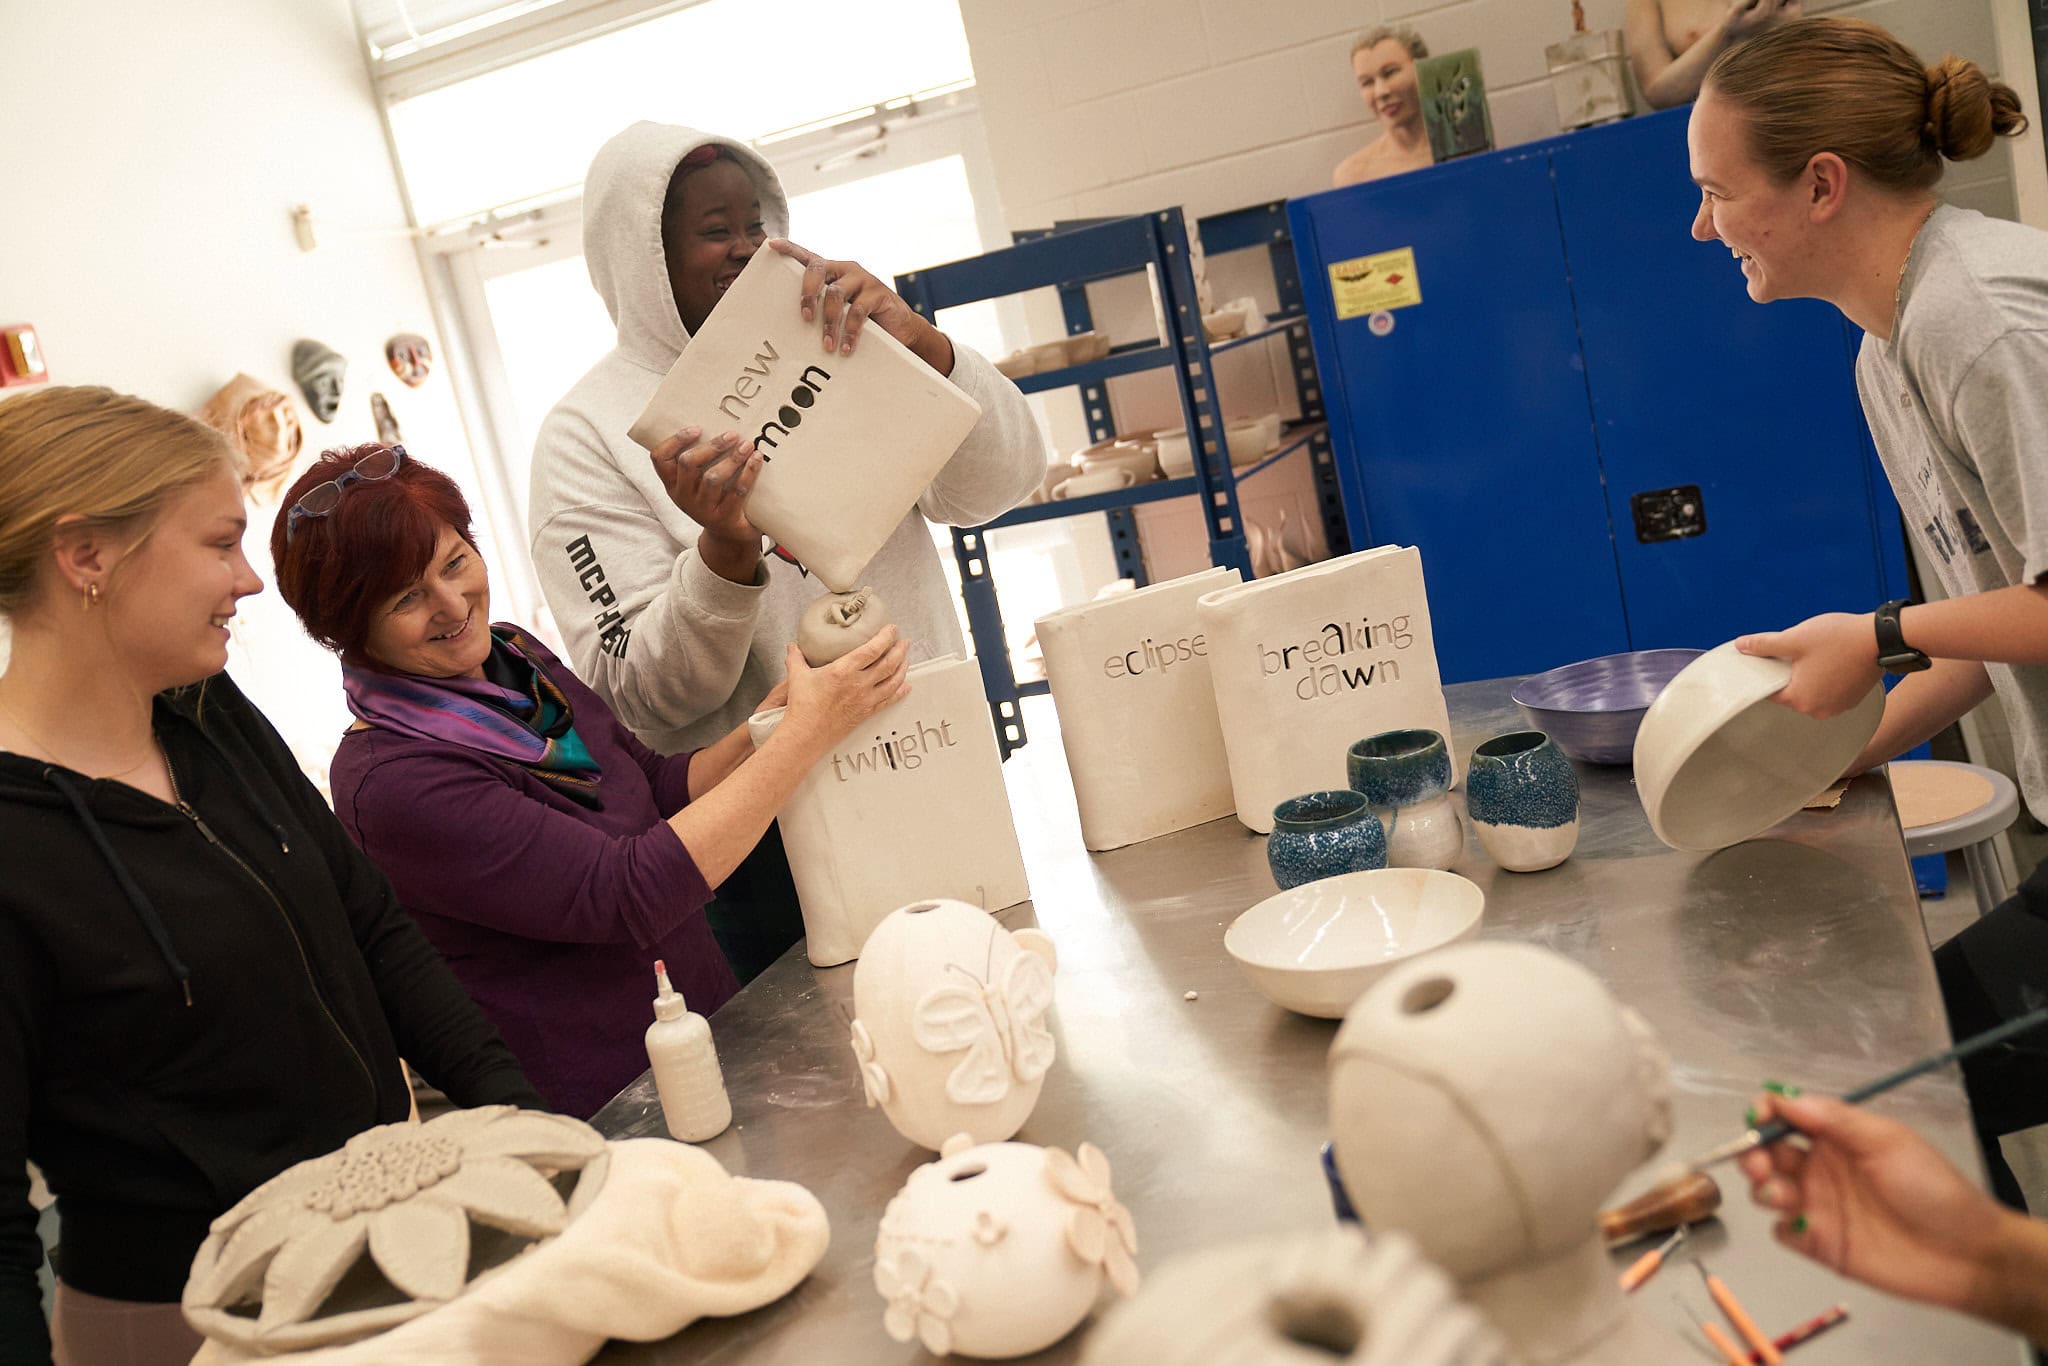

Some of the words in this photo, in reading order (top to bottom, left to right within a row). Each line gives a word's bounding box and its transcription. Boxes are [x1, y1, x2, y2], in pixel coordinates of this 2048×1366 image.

[719, 340, 780, 420] new
[754, 365, 831, 463] moon
[1104, 634, 1208, 680] eclipse
[1257, 615, 1413, 677] breaking
[1296, 658, 1400, 700] dawn
[830, 720, 957, 782] twilight
